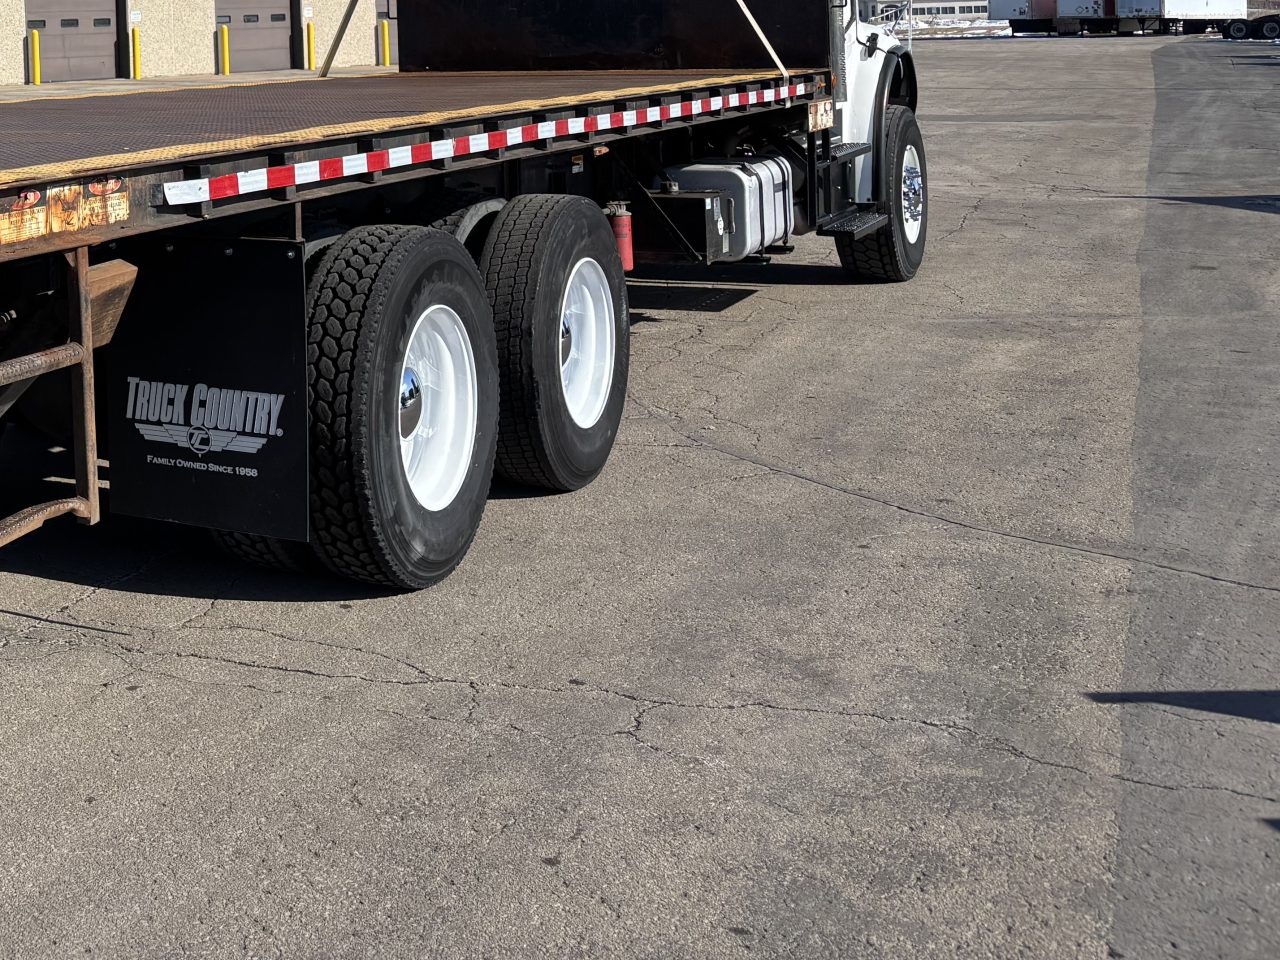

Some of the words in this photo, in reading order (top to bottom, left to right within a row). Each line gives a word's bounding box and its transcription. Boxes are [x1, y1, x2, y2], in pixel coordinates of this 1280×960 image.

[126, 376, 189, 425] TRUCK
[190, 383, 285, 436] COUNTRY
[146, 454, 175, 466] FAMILY
[176, 458, 208, 471] OWNED
[208, 463, 234, 474] SINCE
[235, 466, 259, 477] 1958
